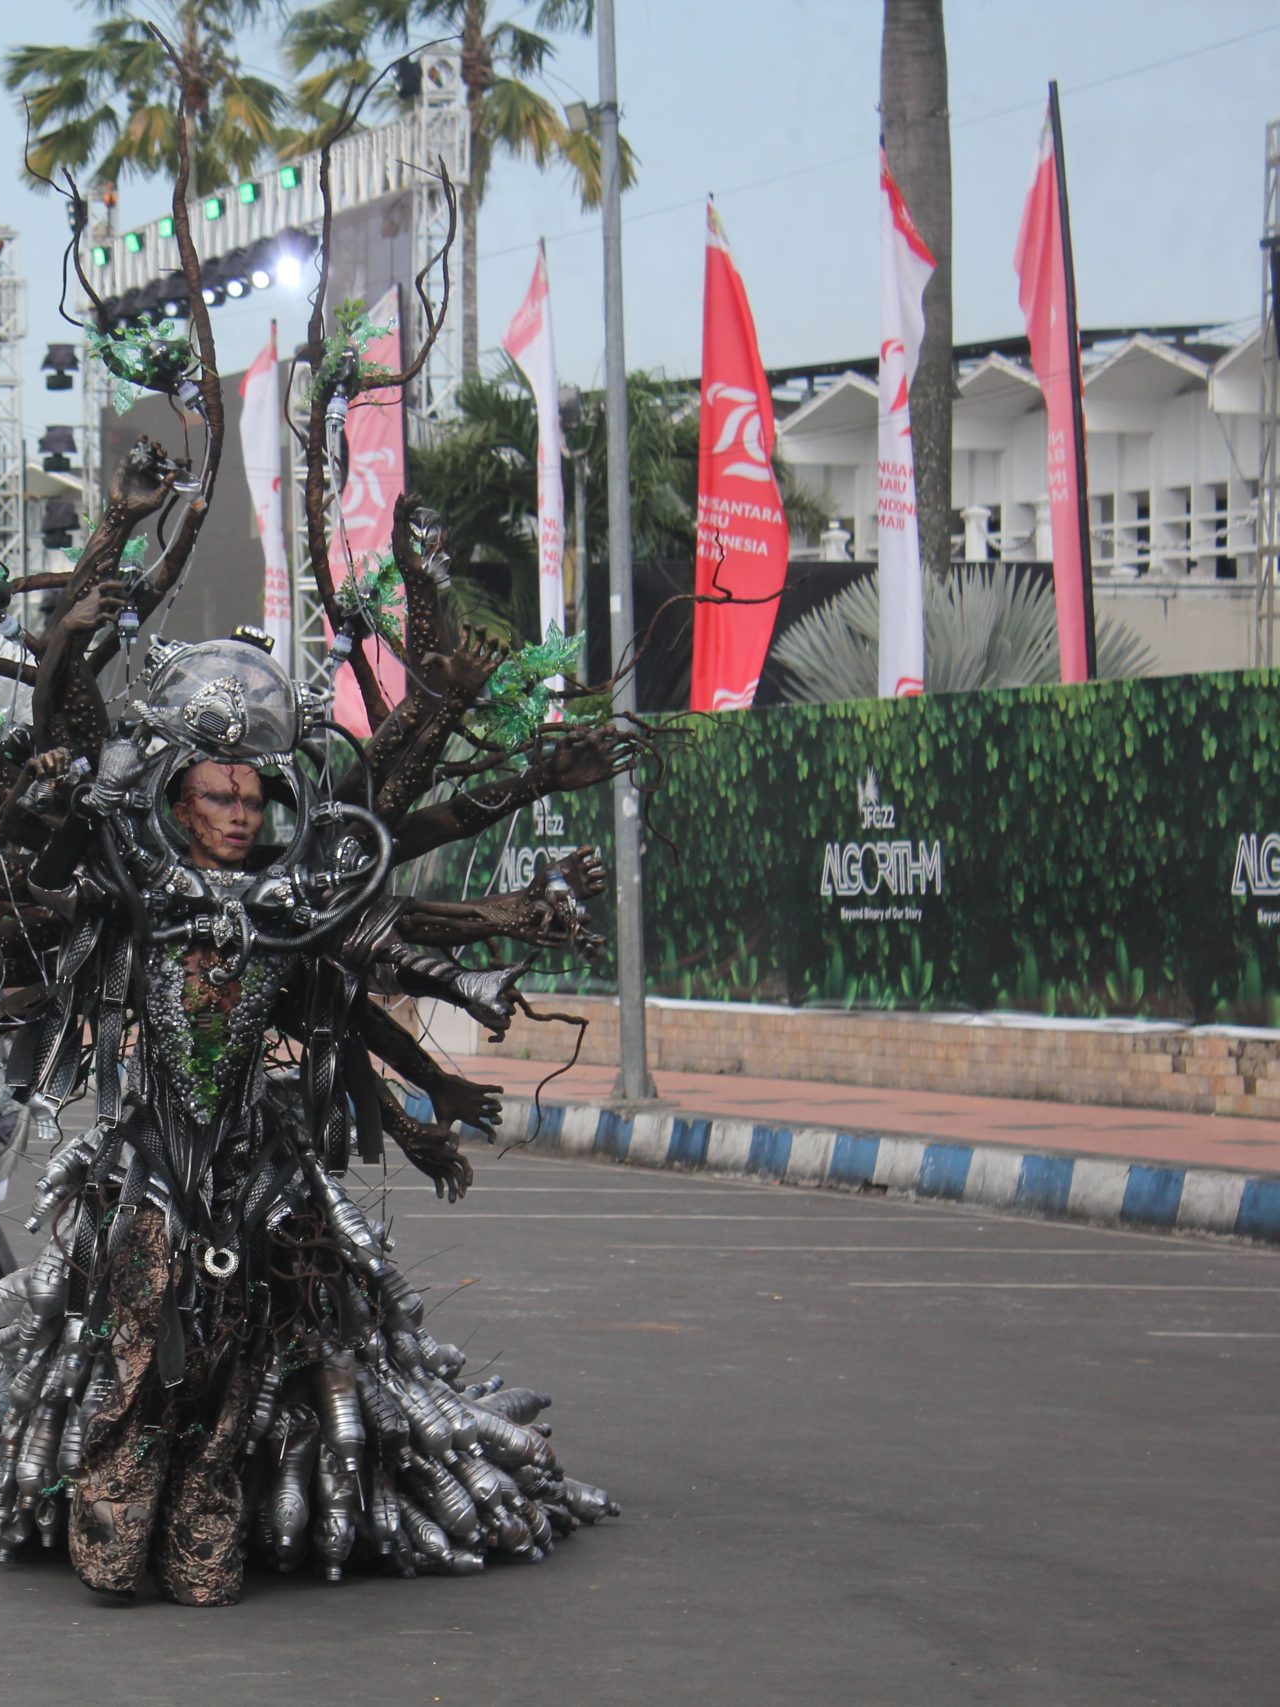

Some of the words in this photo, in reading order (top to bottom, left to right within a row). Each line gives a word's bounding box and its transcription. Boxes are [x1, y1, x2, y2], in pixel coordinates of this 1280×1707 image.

[698, 494, 782, 525] NSANTARA
[861, 804, 896, 829] JFC22
[820, 840, 942, 896] ALGORITHM
[840, 906, 863, 922] Beyond
[885, 906, 892, 920] of
[905, 906, 922, 923] Story
